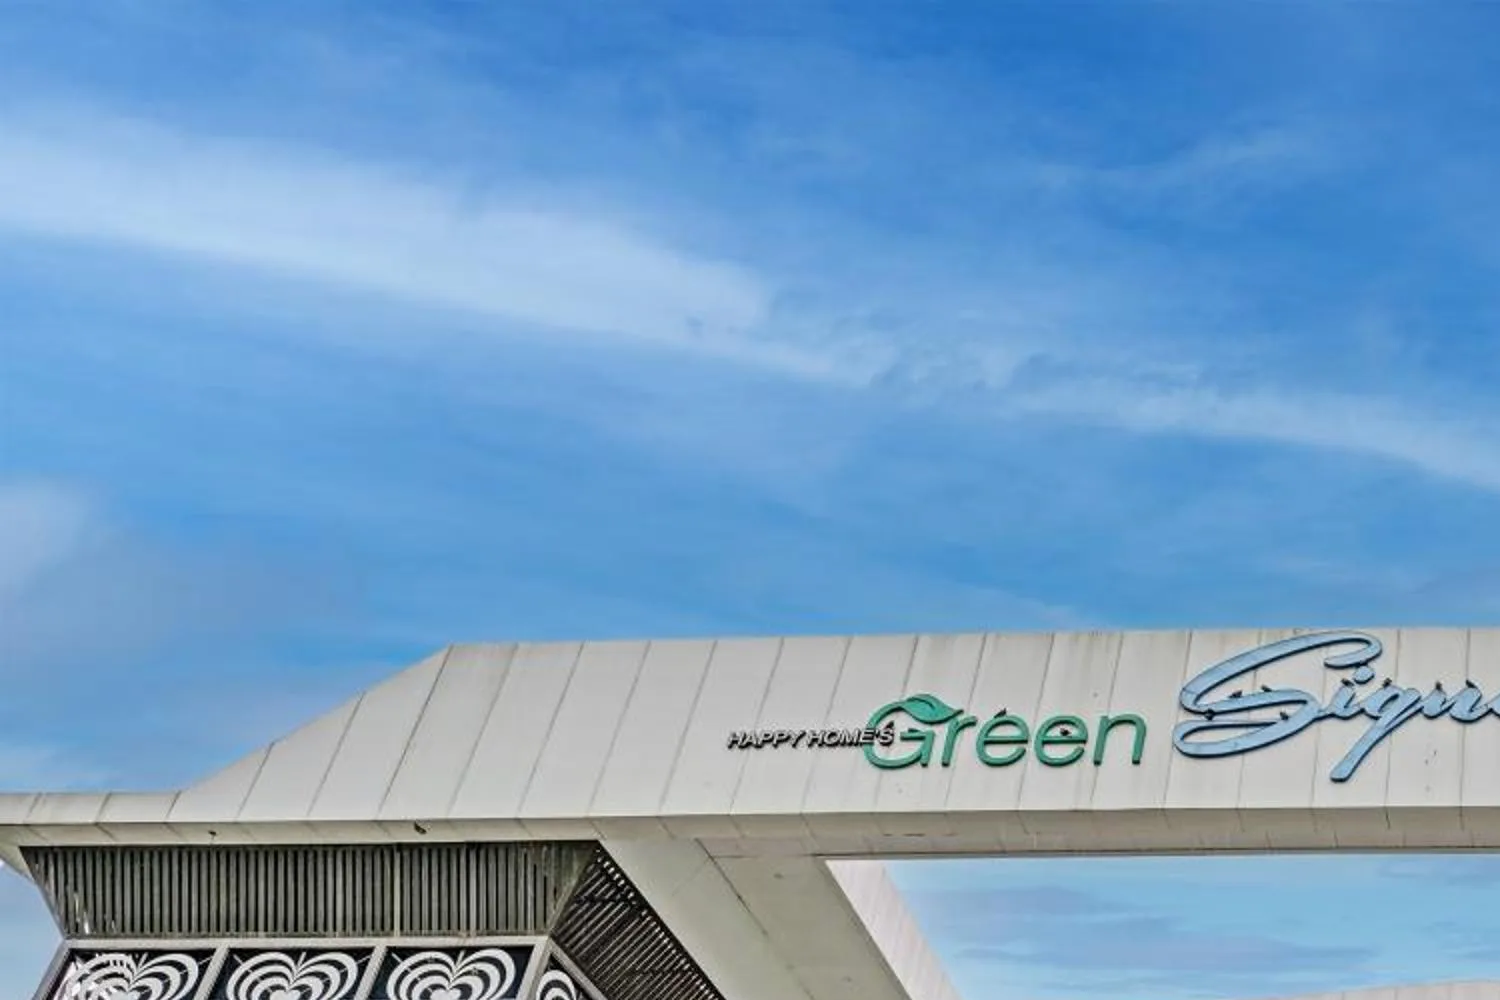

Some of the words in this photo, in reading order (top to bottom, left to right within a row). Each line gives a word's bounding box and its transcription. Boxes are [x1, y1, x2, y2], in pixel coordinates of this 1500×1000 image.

[727, 730, 806, 750] HAPPY
[805, 726, 895, 749] HOME'S
[863, 693, 1148, 769] Green
